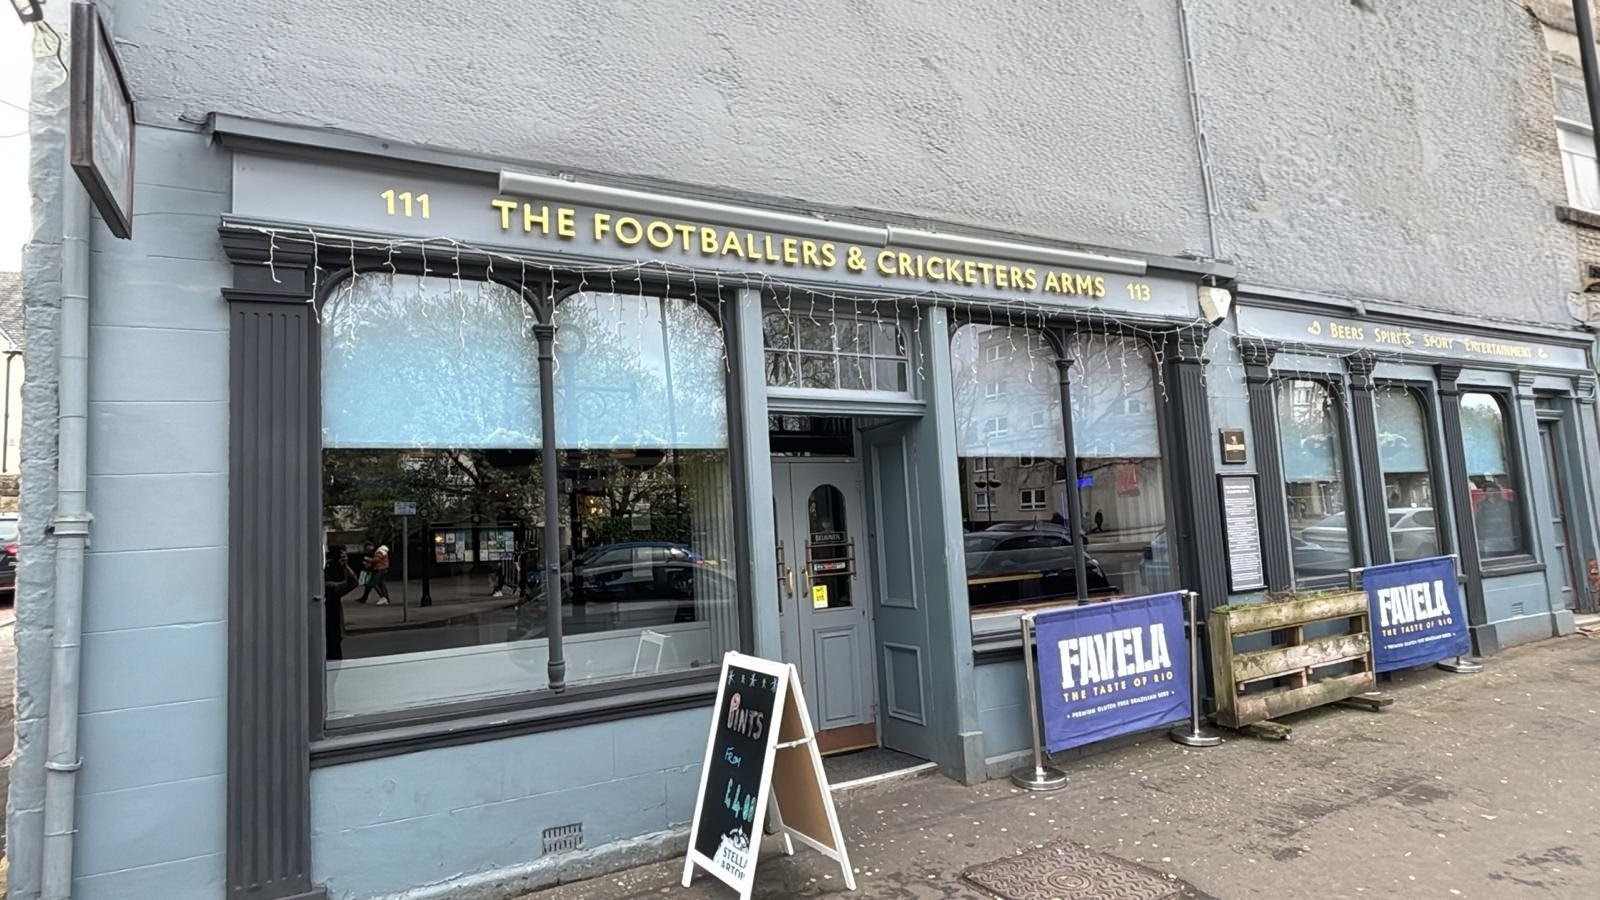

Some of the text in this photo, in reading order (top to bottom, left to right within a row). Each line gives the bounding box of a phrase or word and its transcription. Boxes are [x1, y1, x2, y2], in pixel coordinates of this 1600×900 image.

[380, 189, 430, 219] 111
[491, 199, 1106, 297] THE FOOTBALLERS & CRICKETERS ARMS
[1126, 283, 1151, 301] 113
[1329, 322, 1364, 340] BEERS
[1423, 333, 1453, 349] SPORT
[1464, 338, 1532, 358] ENTERTAINMENT
[1377, 580, 1451, 627] FAVELA
[1382, 618, 1452, 637] THE TASTE OF RIO
[1058, 623, 1172, 689] FAVELA
[1063, 672, 1173, 702] THE TASTE OF RIO
[727, 692, 764, 740] PINTS
[721, 860, 745, 880] ARTOI
